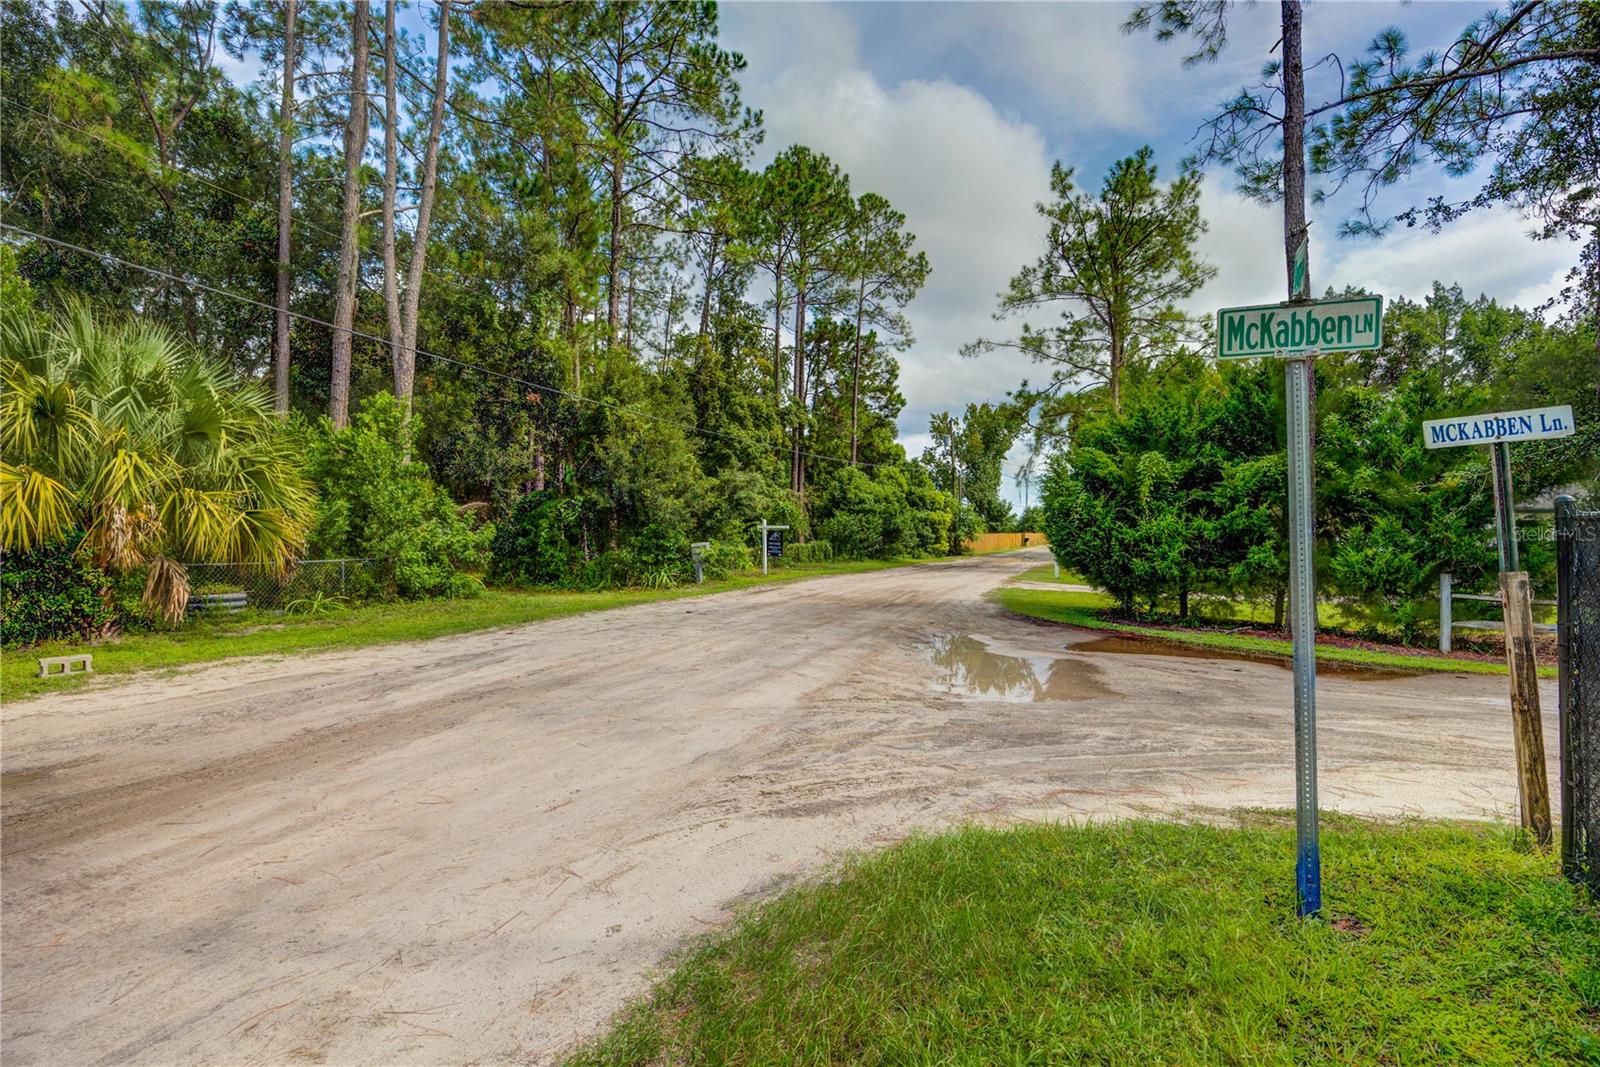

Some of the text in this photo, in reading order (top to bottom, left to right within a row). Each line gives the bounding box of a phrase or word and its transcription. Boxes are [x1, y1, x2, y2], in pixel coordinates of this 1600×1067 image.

[1227, 310, 1373, 351] McKabben LN
[1430, 413, 1568, 443] MCKABBEN Ln.
